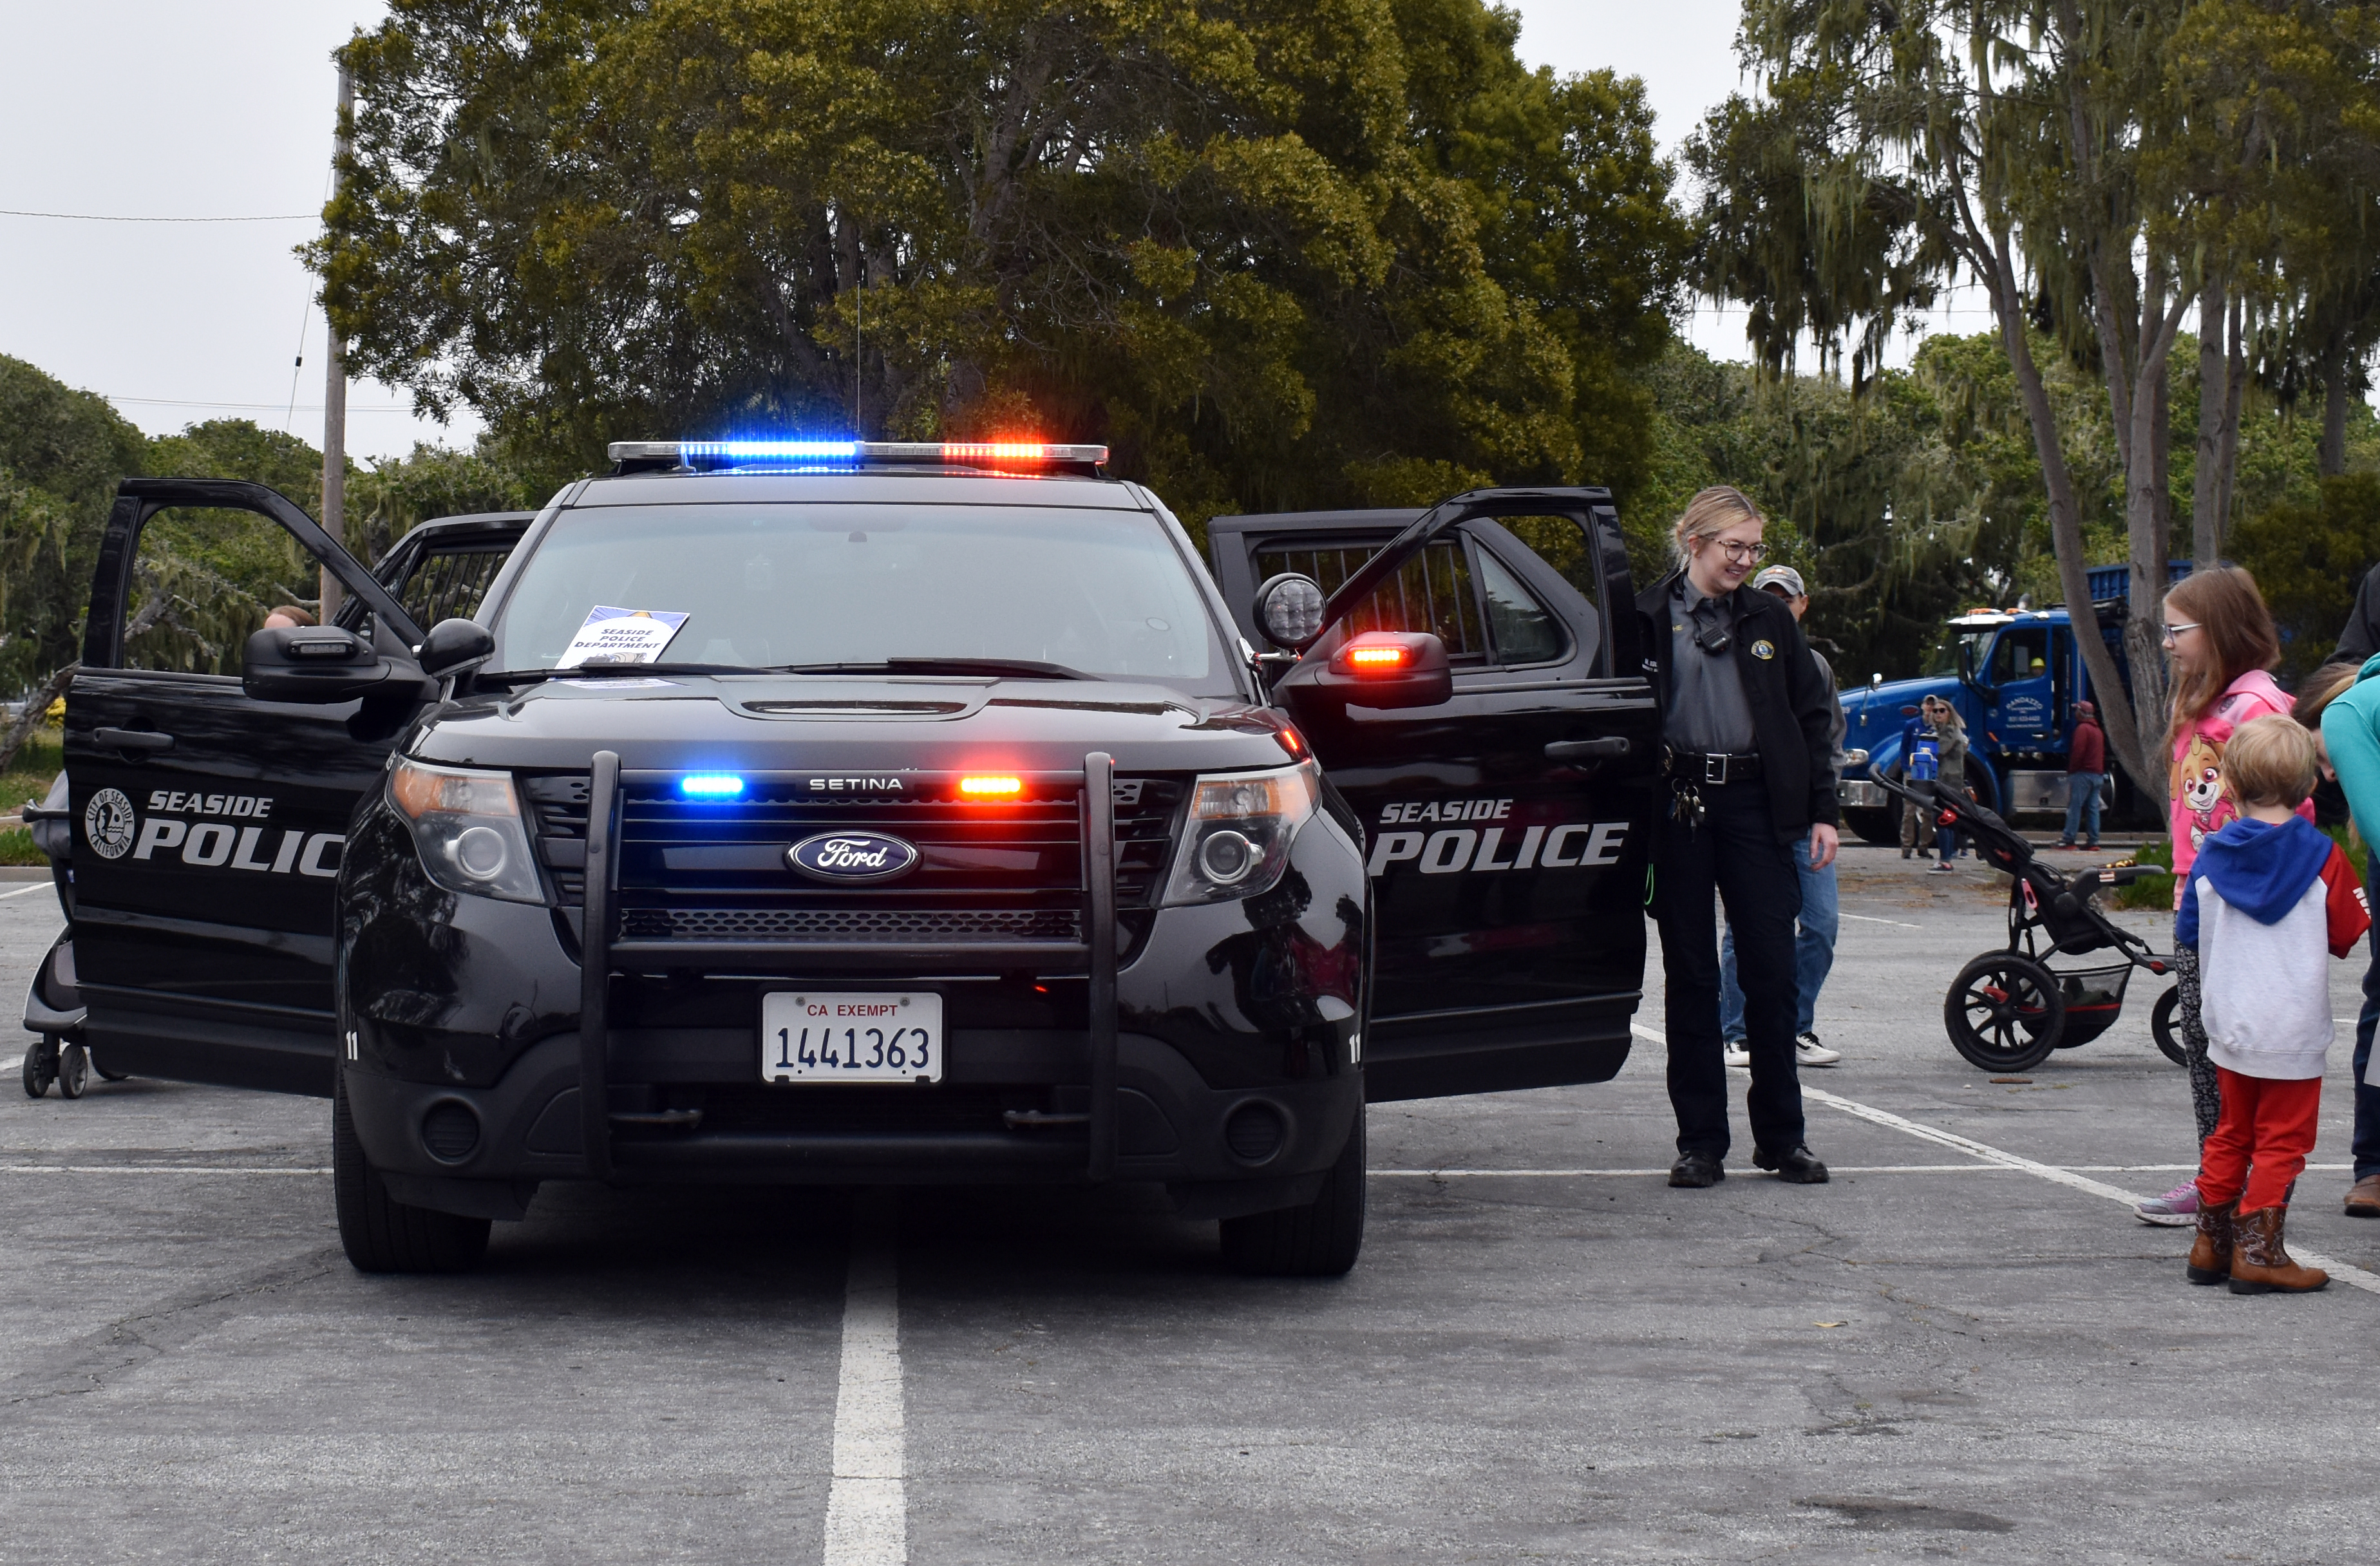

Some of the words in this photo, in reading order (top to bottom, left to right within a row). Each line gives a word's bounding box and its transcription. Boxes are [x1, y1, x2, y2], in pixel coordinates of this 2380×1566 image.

[809, 778, 903, 790] SETINA
[87, 799, 99, 821] CITY
[99, 790, 108, 803] OF
[111, 791, 133, 825] SEASIDE
[147, 790, 273, 818] SEASIDE
[1379, 798, 1513, 824] SEASIDE
[90, 833, 131, 857] CALIFORNIA
[133, 818, 346, 878] POLIC
[817, 838, 888, 867] Ford
[1368, 822, 1629, 876] POLICE
[807, 1005, 828, 1016] CA
[837, 1005, 898, 1016] EXEMPT
[346, 1030, 358, 1061] 11
[776, 1028, 929, 1068] 1441363
[1349, 1032, 1361, 1064] 11
